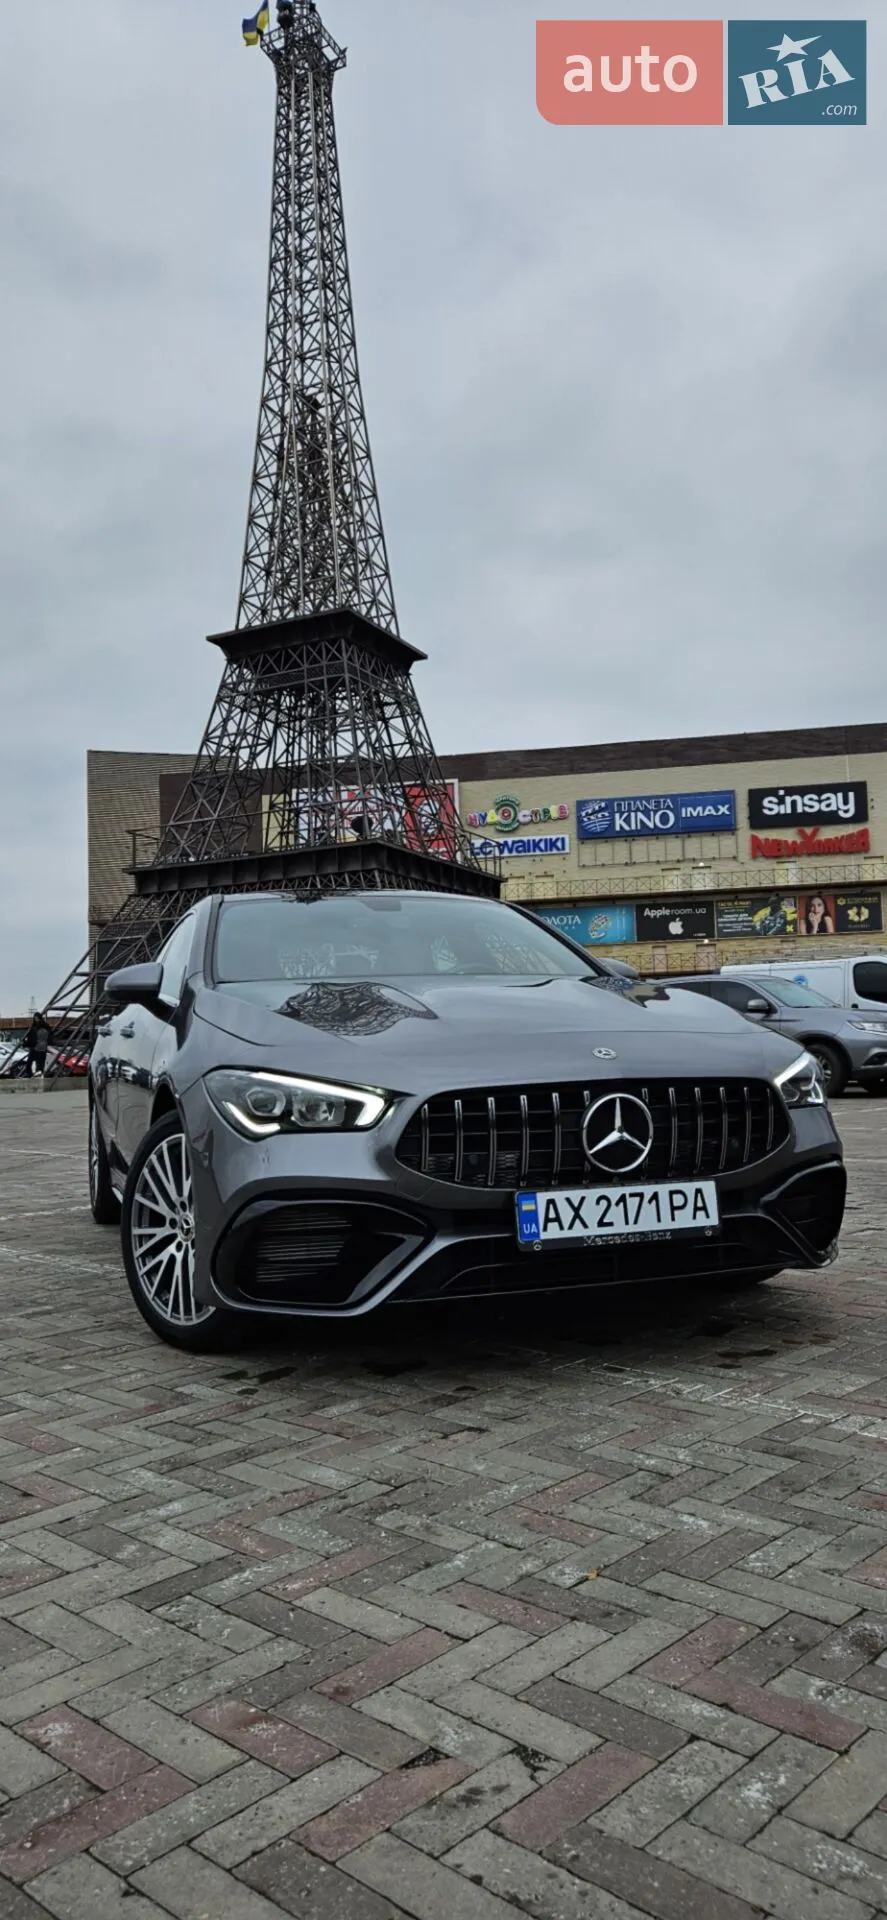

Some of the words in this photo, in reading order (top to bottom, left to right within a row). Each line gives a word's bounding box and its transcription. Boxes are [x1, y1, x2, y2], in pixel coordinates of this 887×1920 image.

[681, 804, 731, 818] IMAX
[762, 790, 855, 818] sinsay
[615, 809, 676, 832] KINO
[542, 1196, 589, 1233] AX
[595, 1191, 662, 1228] 2171
[668, 1188, 710, 1222] PA
[523, 1223, 538, 1235] UA
